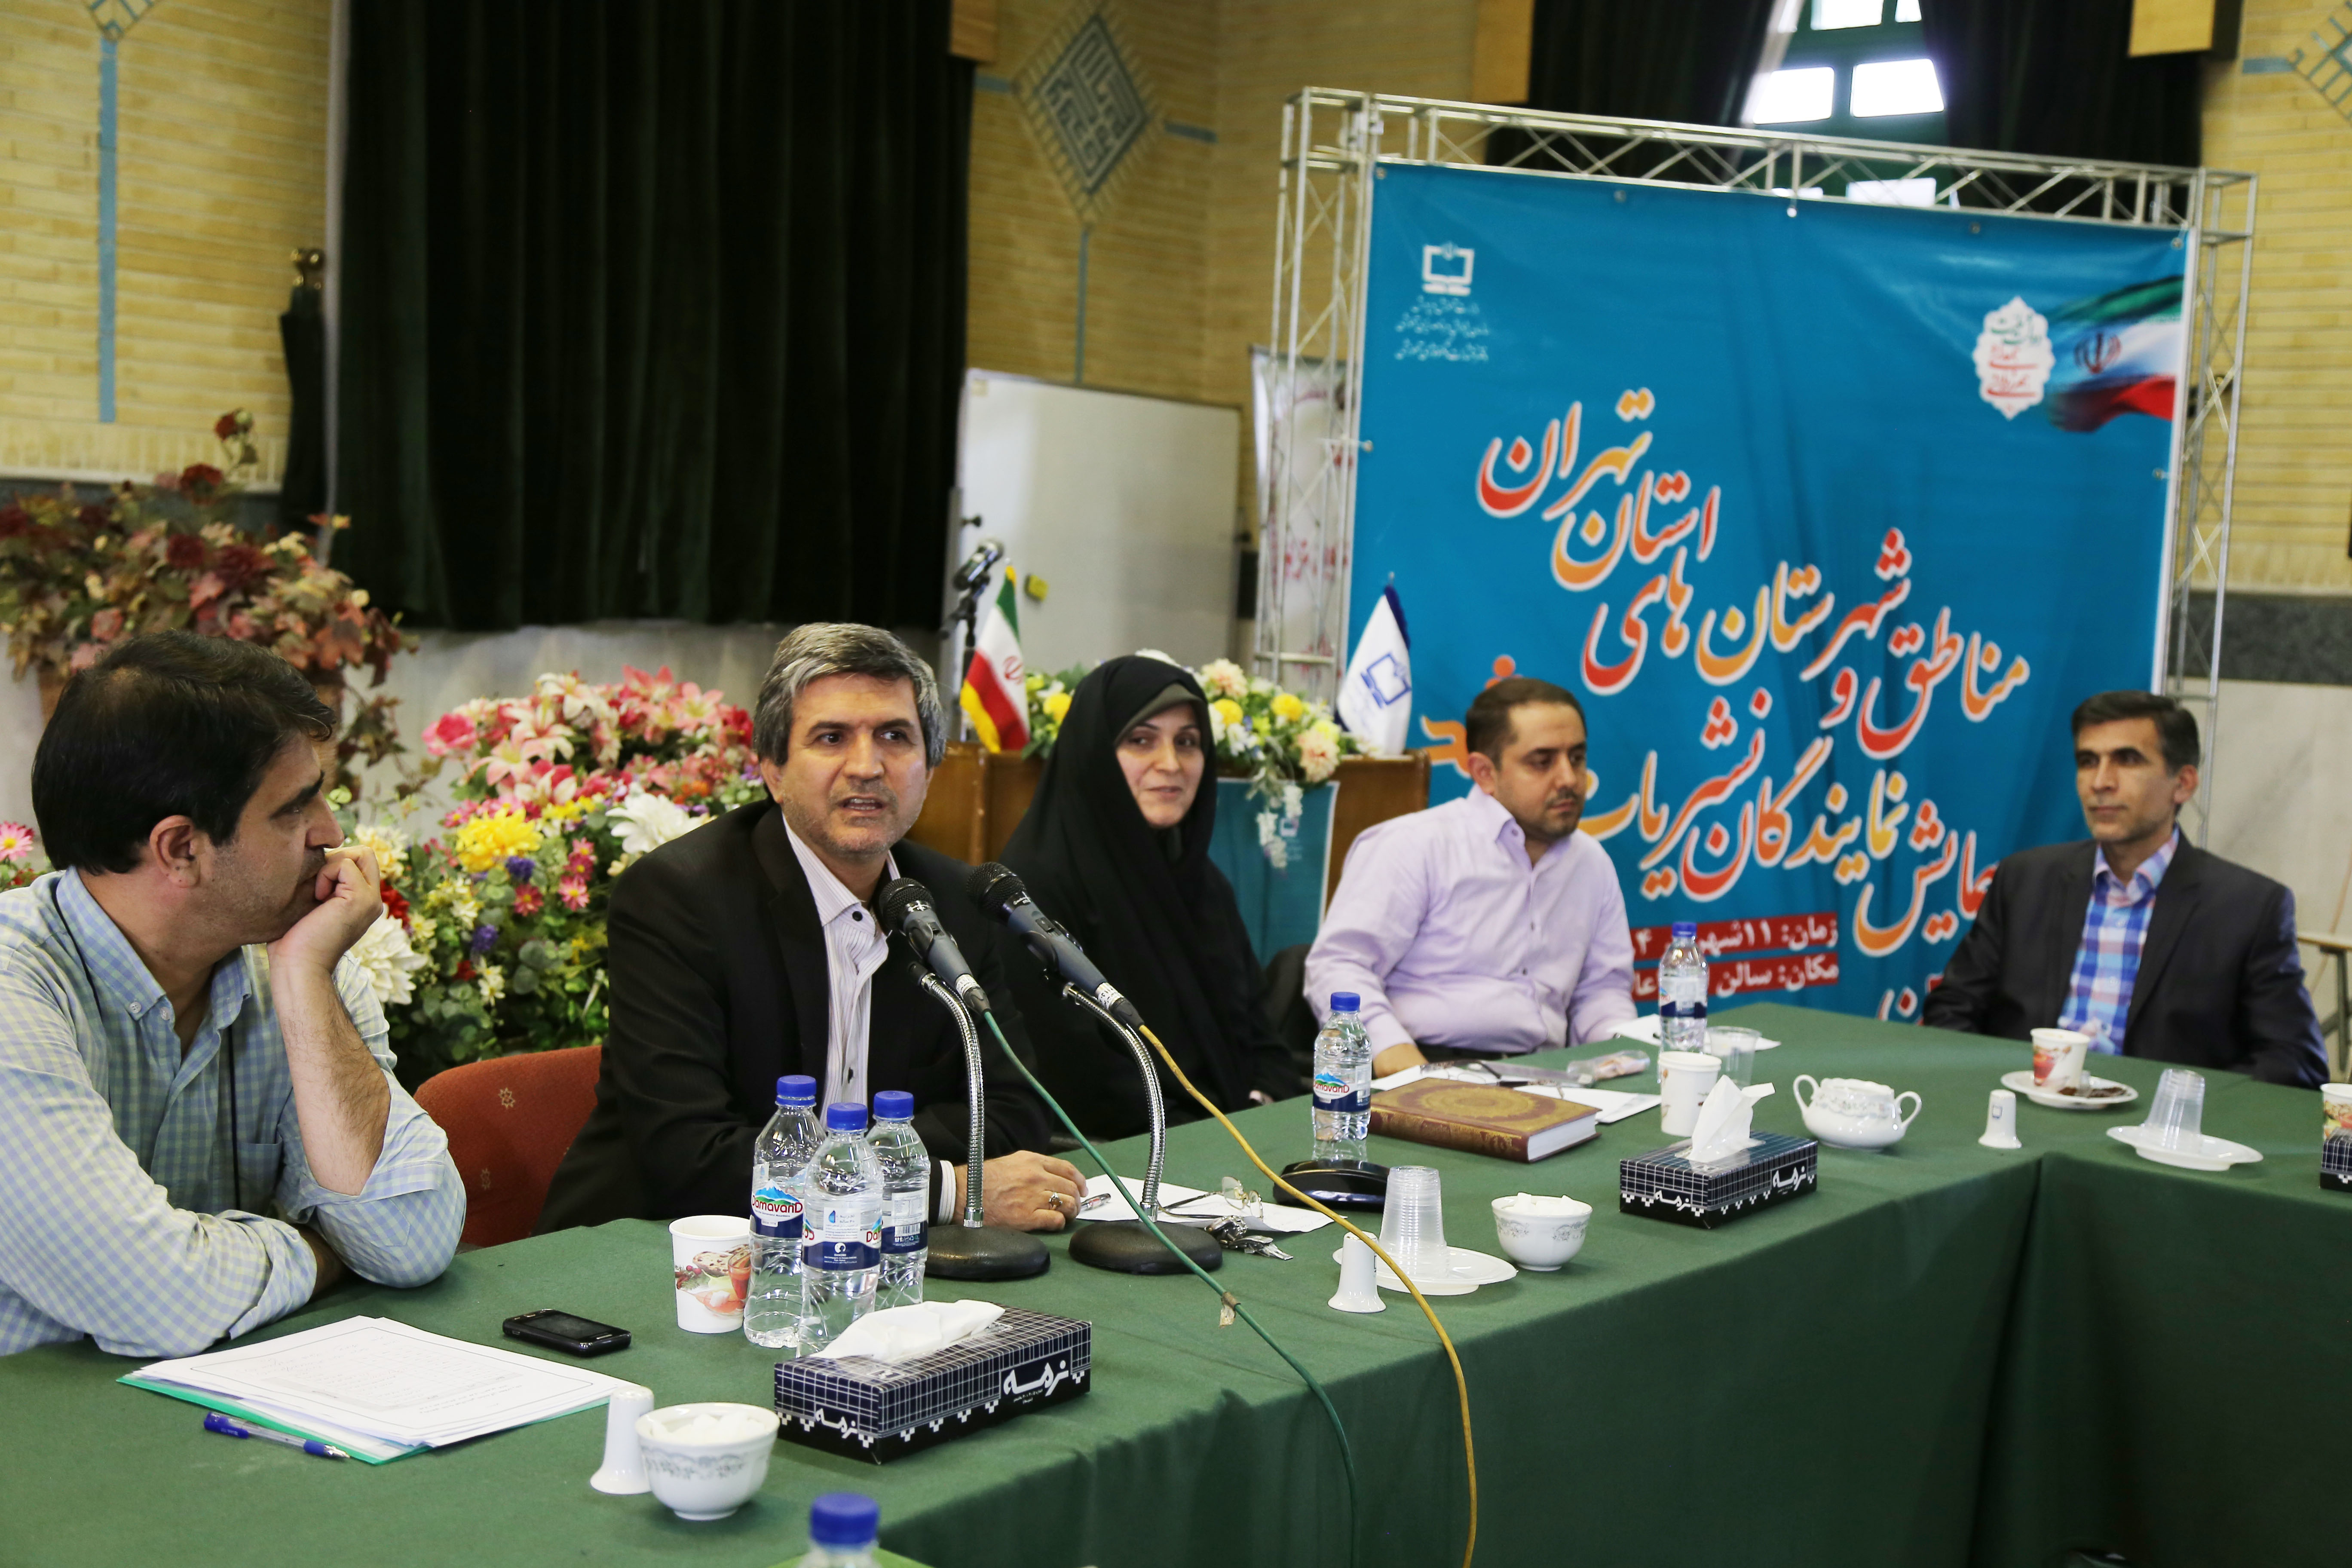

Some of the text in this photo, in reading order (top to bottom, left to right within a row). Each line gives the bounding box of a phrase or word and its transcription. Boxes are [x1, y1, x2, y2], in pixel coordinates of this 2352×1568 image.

[1476, 387, 1721, 592] استان تهران
[1819, 665, 1858, 729] و
[1856, 606, 2030, 760] مناطق
[1678, 736, 1910, 902] نمایندگان
[1852, 798, 2001, 958] مایش
[1781, 915, 1838, 952] زمان:
[1715, 953, 1839, 998] مکان: سالن
[1655, 1189, 1691, 1211] نرمه
[1773, 1165, 1807, 1191] نرمه
[1004, 1360, 1069, 1396] نرمه
[816, 1408, 858, 1439] نرمه
